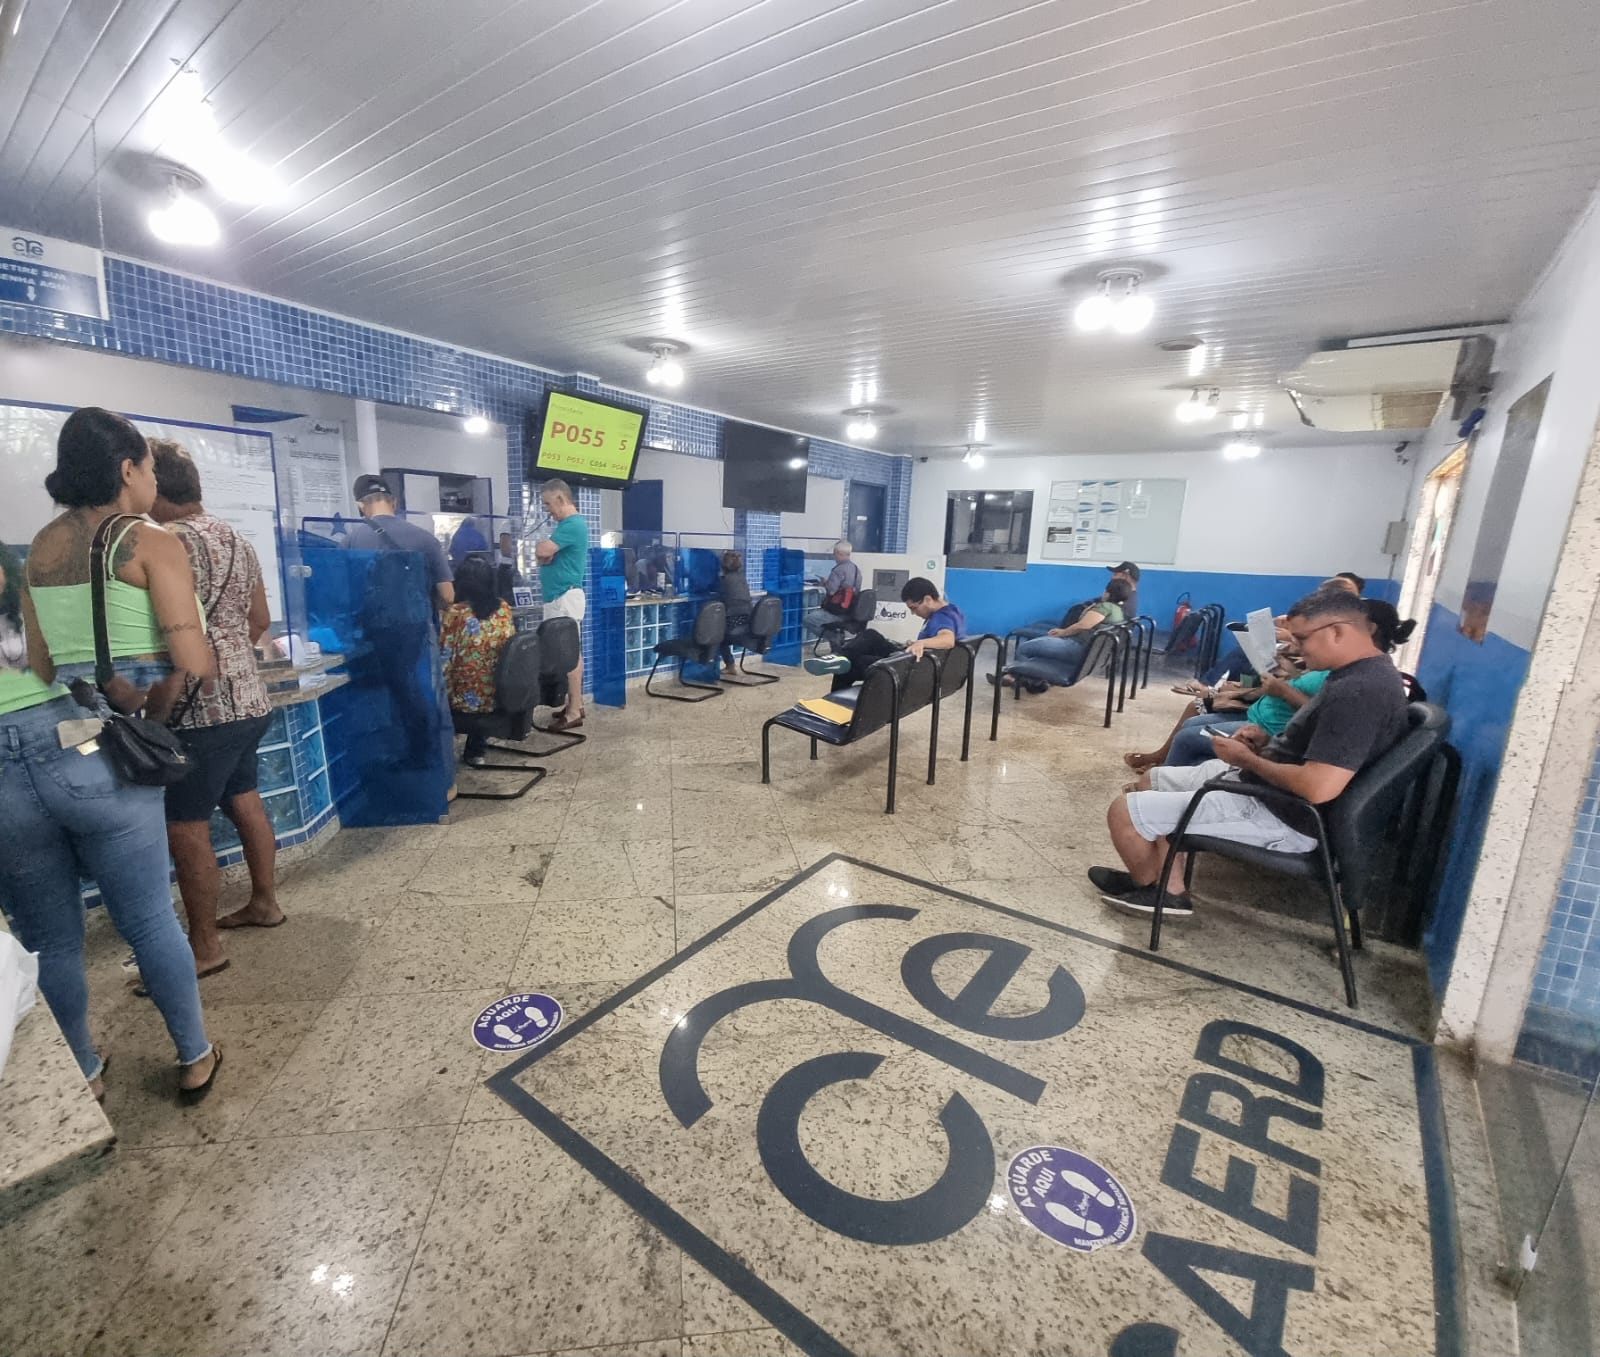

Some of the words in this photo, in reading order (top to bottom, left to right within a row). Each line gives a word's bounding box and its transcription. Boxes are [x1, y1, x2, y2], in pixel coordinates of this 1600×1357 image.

[0, 262, 39, 275] ETIRE
[551, 421, 606, 448] P055
[618, 439, 628, 451] 5
[477, 995, 530, 1028] AGUARDE
[495, 1005, 522, 1023] AQUI
[1012, 1150, 1054, 1208] AGUARDE
[1032, 1167, 1057, 1198] AQUI
[1107, 1019, 1326, 1357] AERD
